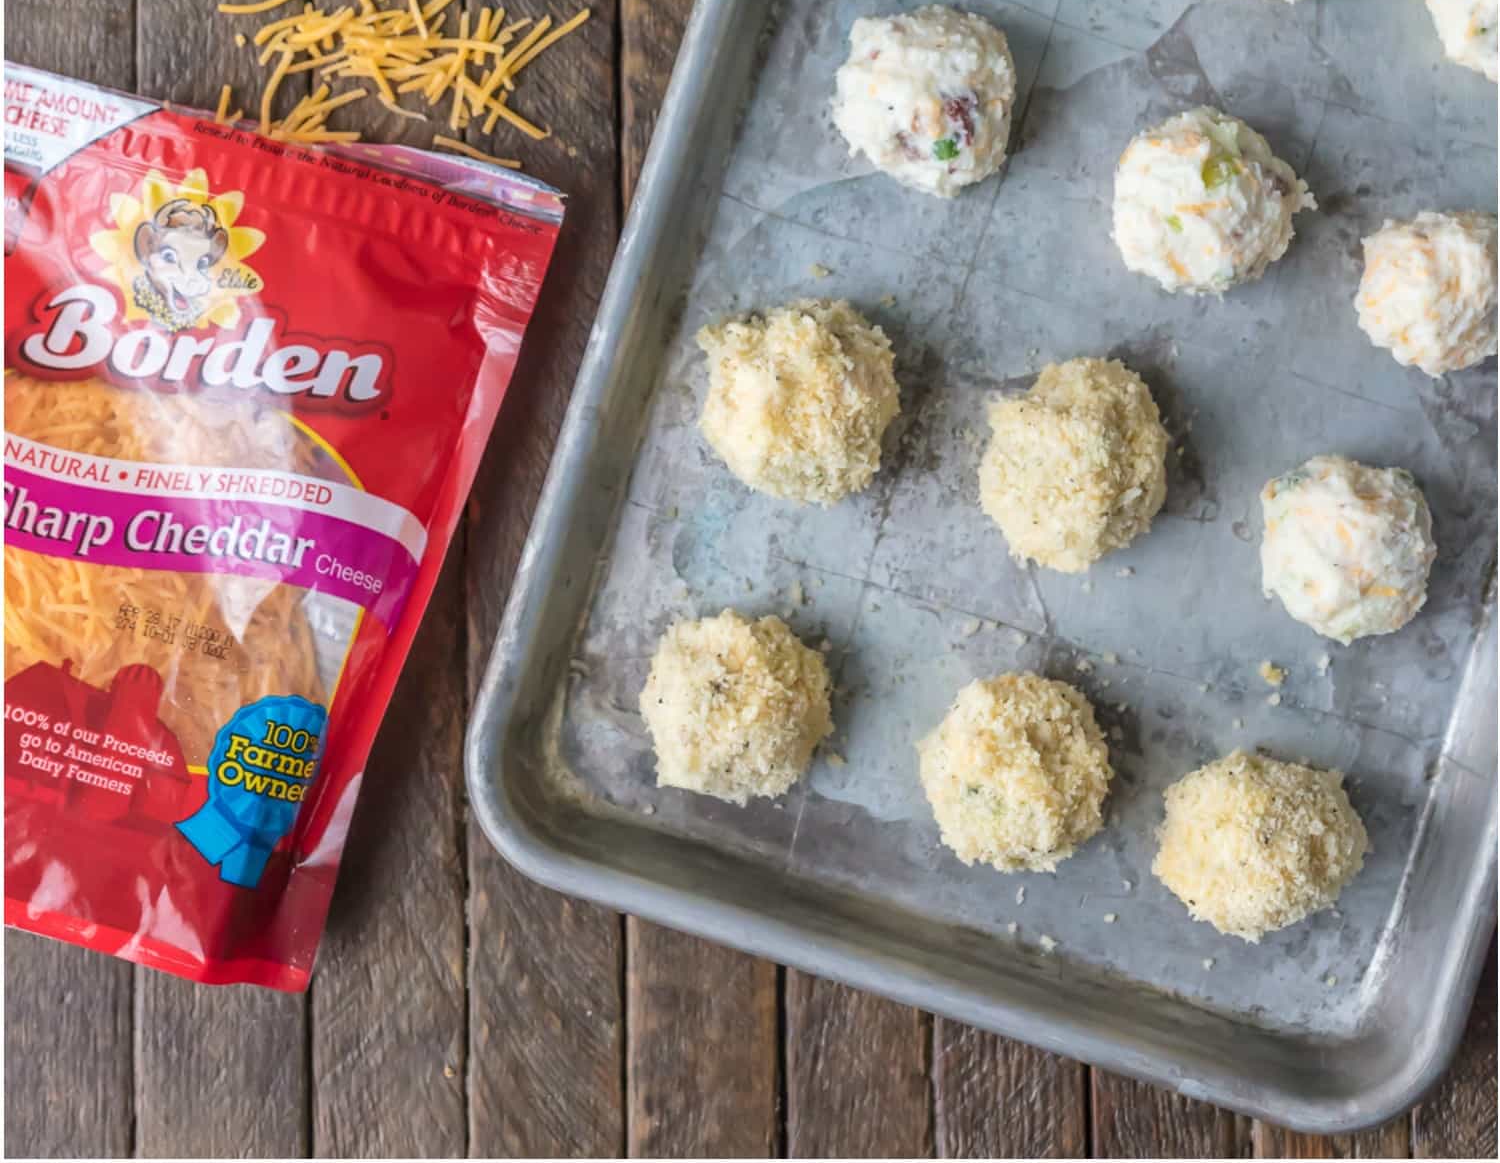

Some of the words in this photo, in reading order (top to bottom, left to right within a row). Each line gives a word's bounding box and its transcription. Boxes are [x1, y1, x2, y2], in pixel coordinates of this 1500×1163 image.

[4, 104, 70, 137] CHEESE
[35, 88, 120, 124] AMOUNT
[296, 148, 315, 164] the
[319, 155, 371, 180] Natural
[431, 188, 447, 204] of
[217, 267, 258, 289] Elsie
[24, 283, 383, 401] Borden
[4, 438, 112, 484] NATURAL
[134, 469, 212, 493] FINELY
[214, 473, 333, 506] SHREDDED
[125, 509, 316, 569] Cheddar
[315, 553, 384, 594] Cheese
[4, 703, 50, 731] 100%
[53, 721, 72, 736] of
[72, 727, 100, 746] our
[102, 734, 175, 767] Proceeds
[19, 732, 42, 748] go
[44, 737, 62, 754] to
[63, 743, 143, 779] American
[18, 749, 64, 778] Dairy
[65, 764, 133, 796] Farmers
